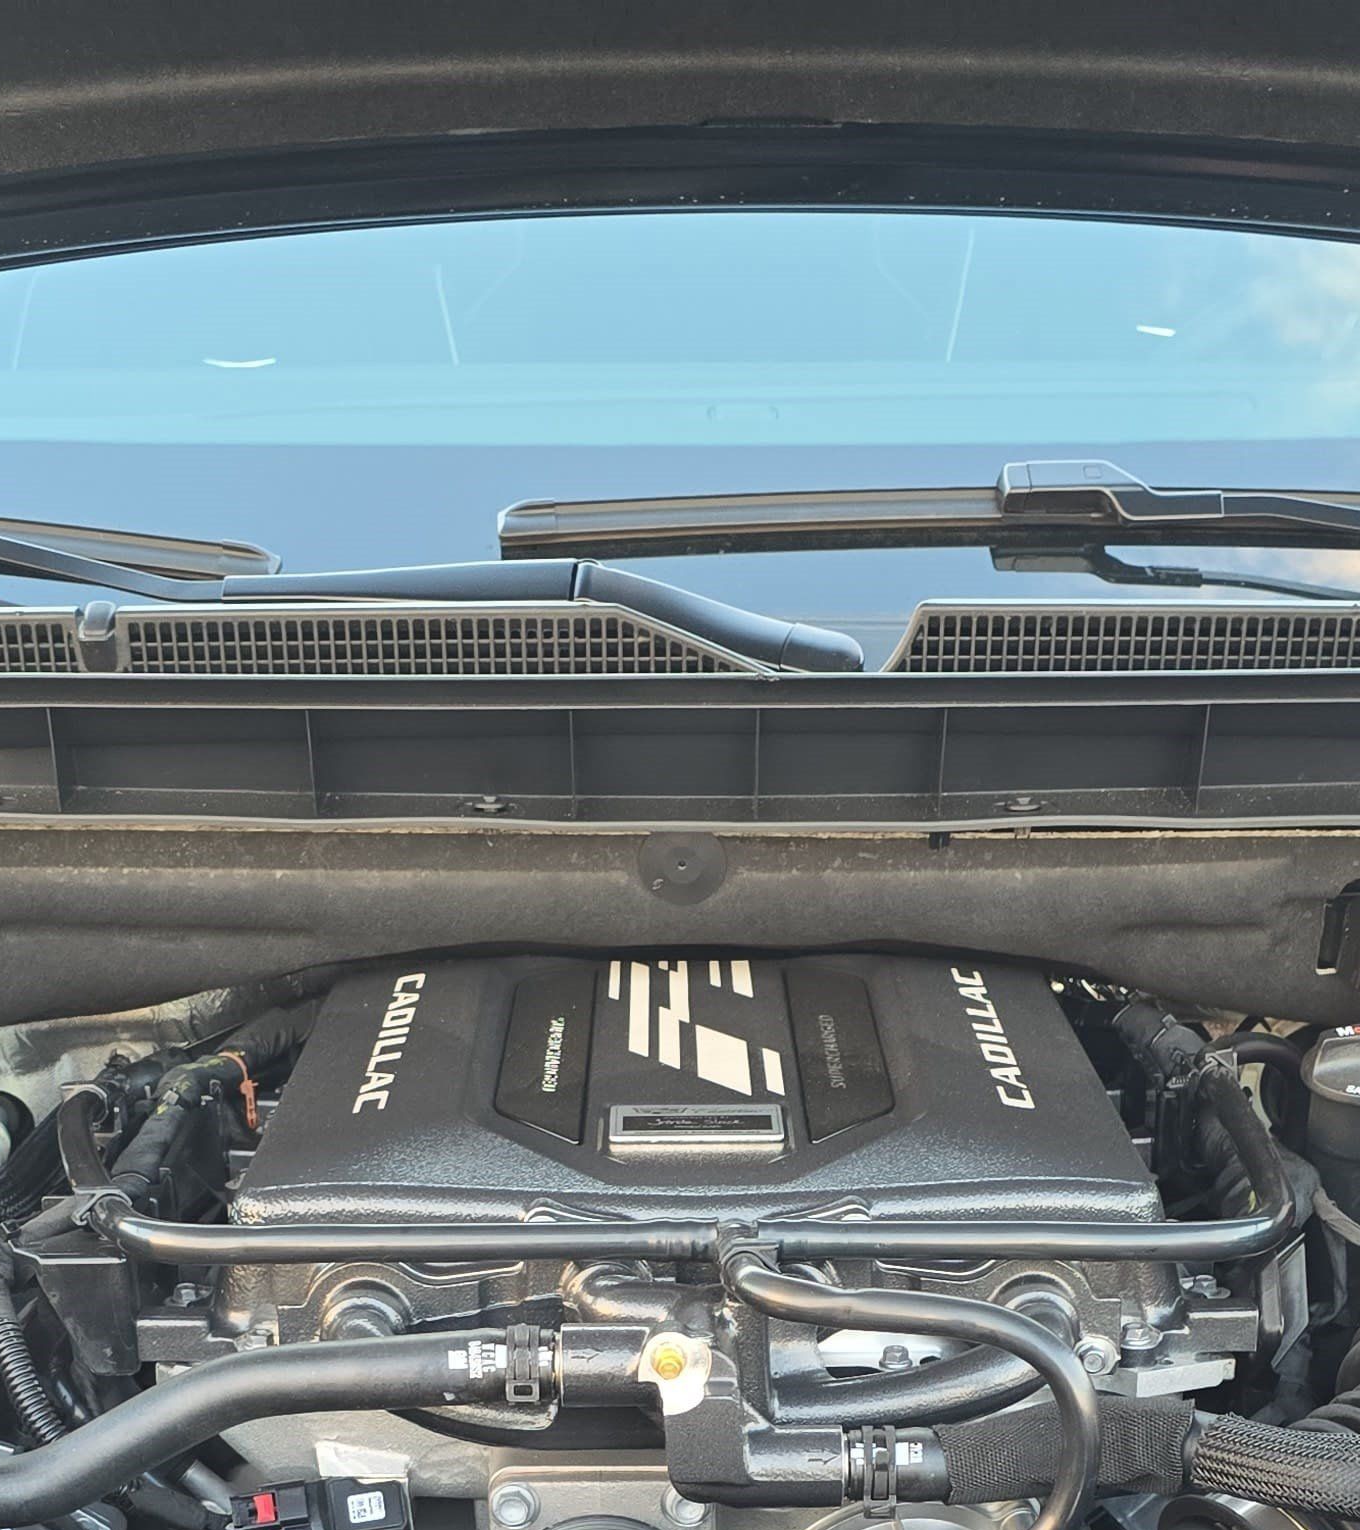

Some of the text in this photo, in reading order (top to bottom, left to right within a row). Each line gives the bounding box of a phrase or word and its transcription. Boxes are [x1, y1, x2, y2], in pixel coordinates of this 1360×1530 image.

[351, 972, 426, 1114] CADILLAC
[818, 1014, 847, 1089] SUPERCHARGED
[950, 967, 1036, 1109] CADILLAC
